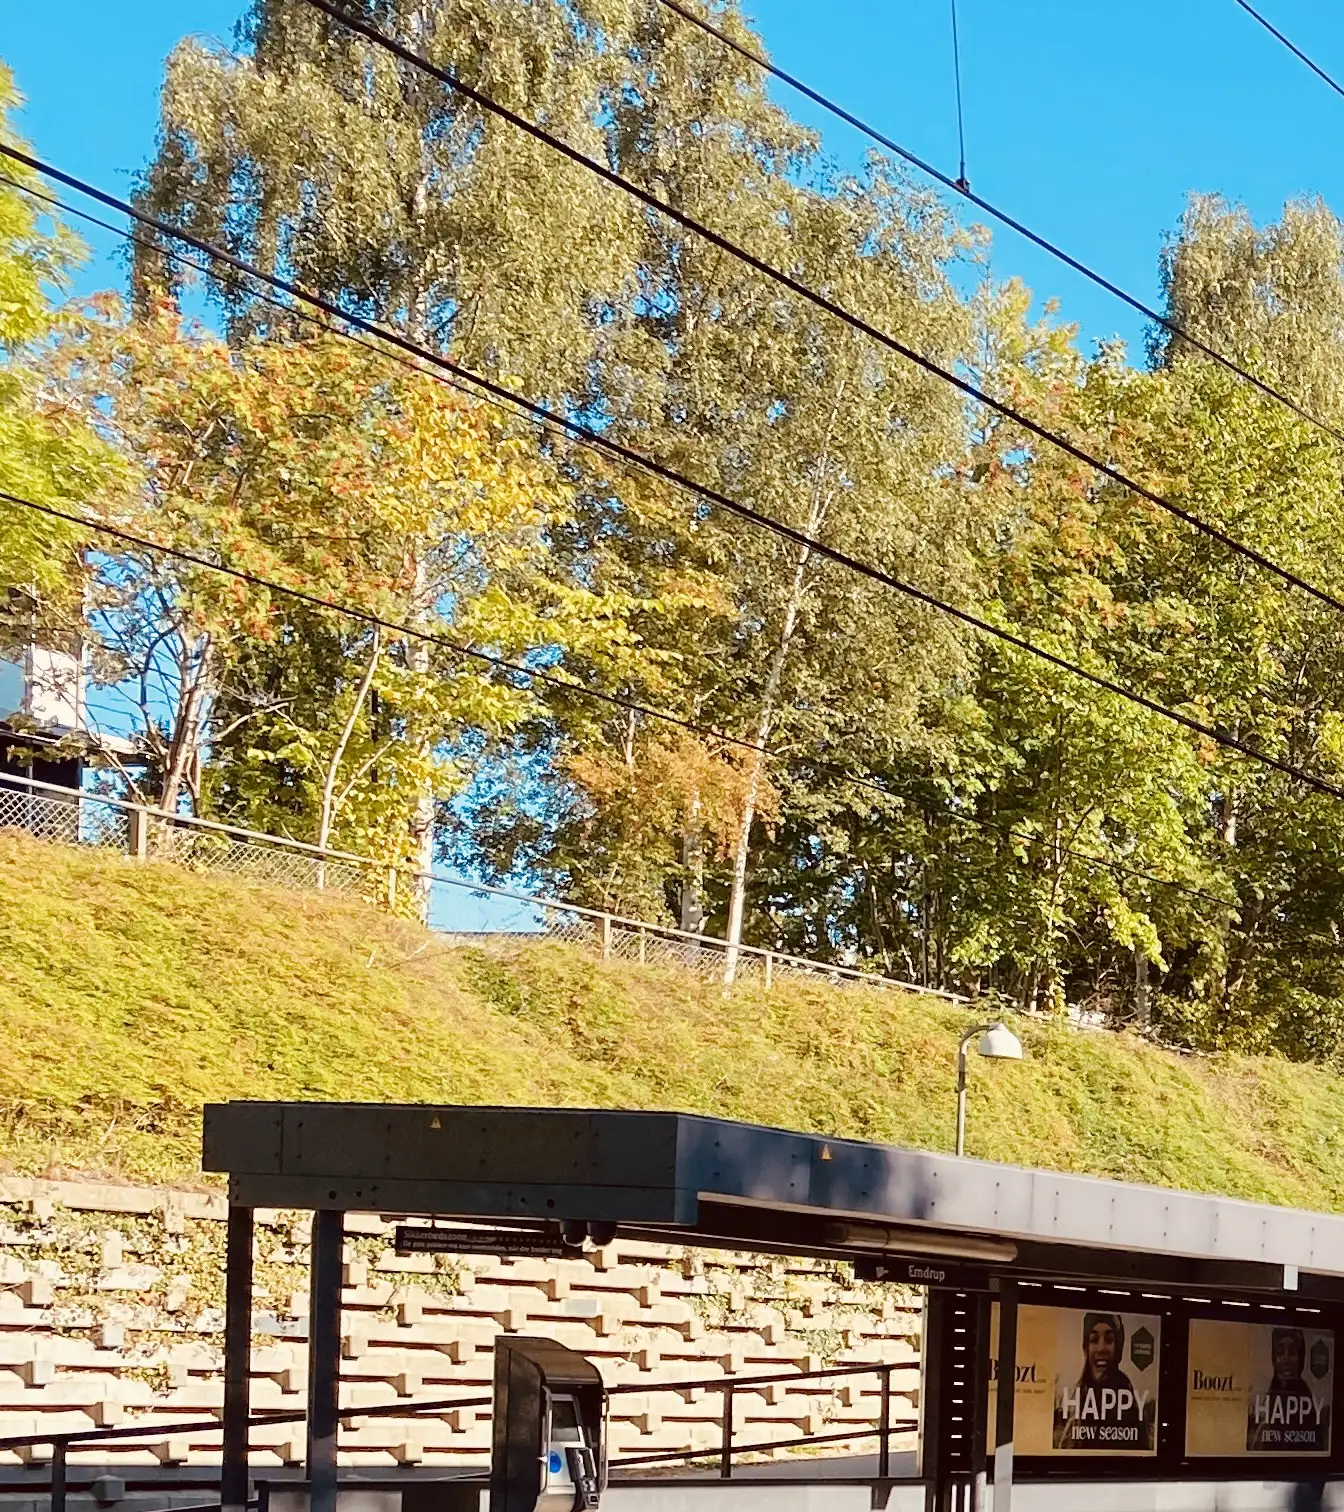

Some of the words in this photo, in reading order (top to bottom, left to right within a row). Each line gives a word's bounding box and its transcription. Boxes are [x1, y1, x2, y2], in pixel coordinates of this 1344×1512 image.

[908, 1265, 945, 1282] Emdrup
[1061, 1386, 1149, 1422] HAPPY
[1254, 1393, 1325, 1426] HAPPY
[1070, 1425, 1097, 1441] new
[1098, 1425, 1139, 1441] season
[1260, 1428, 1282, 1443] new
[1283, 1429, 1316, 1444] season
